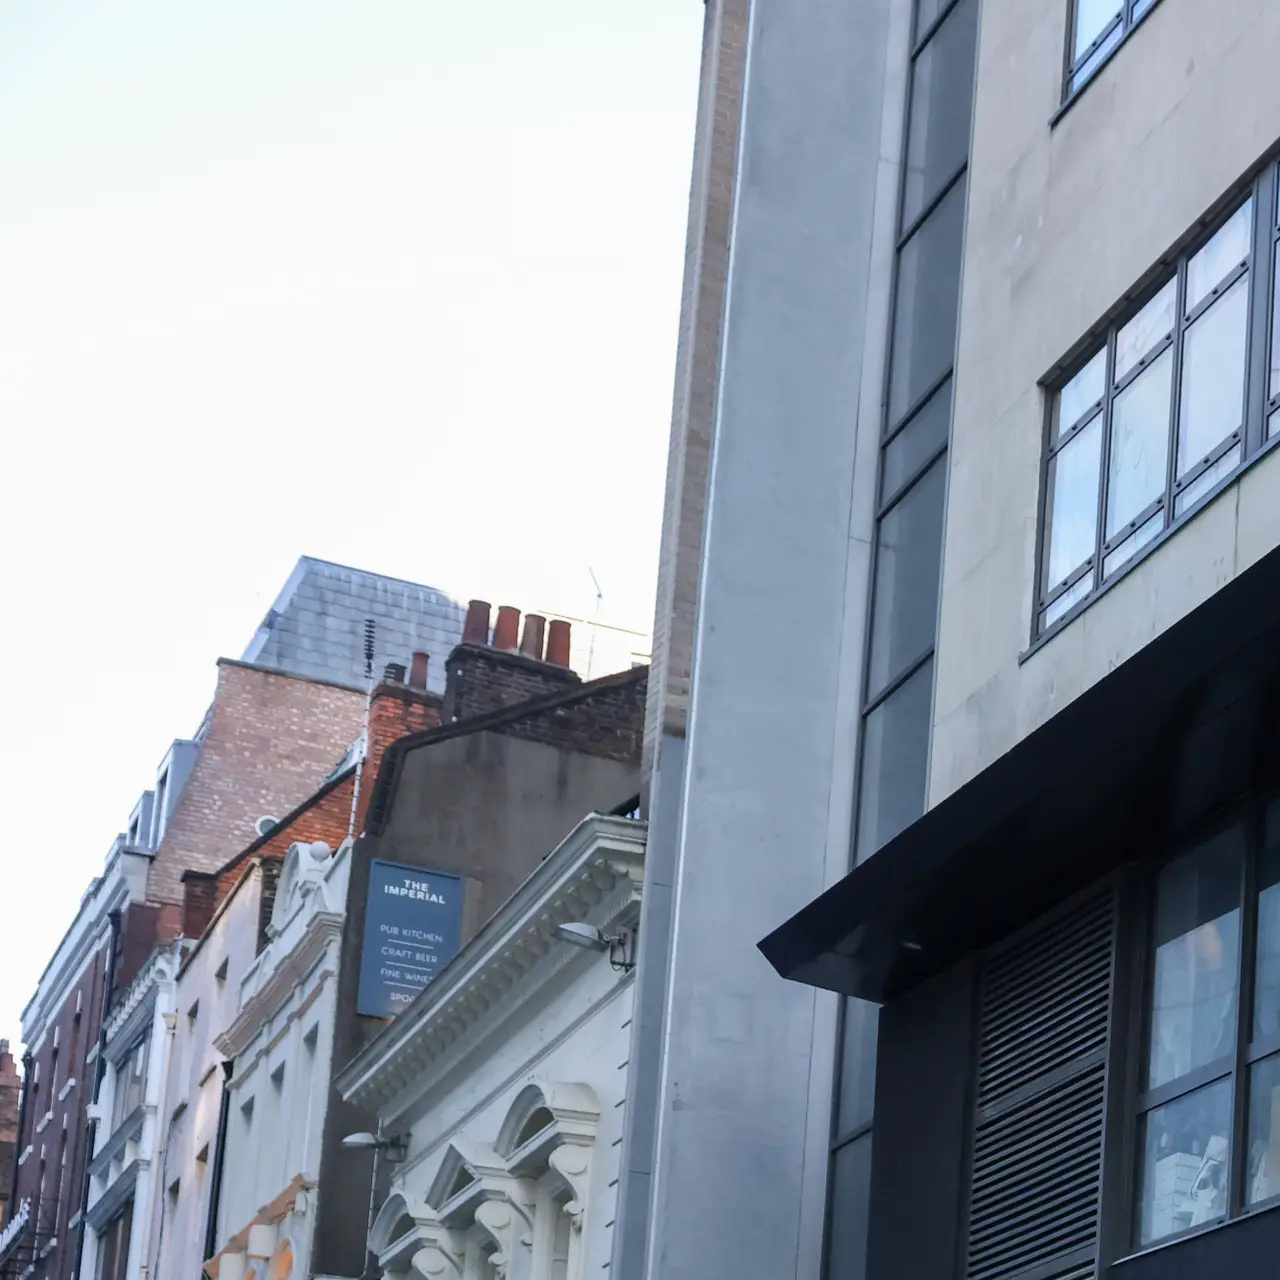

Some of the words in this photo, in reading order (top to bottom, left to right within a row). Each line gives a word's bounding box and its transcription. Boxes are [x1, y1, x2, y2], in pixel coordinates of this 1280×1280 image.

[384, 885, 446, 904] IMPERIAL
[404, 879, 429, 892] THE
[380, 924, 399, 936] PUB
[402, 928, 443, 942] KITCHEN
[381, 946, 412, 960] CRAFT
[415, 952, 438, 964] BEER
[380, 967, 400, 979] FINE
